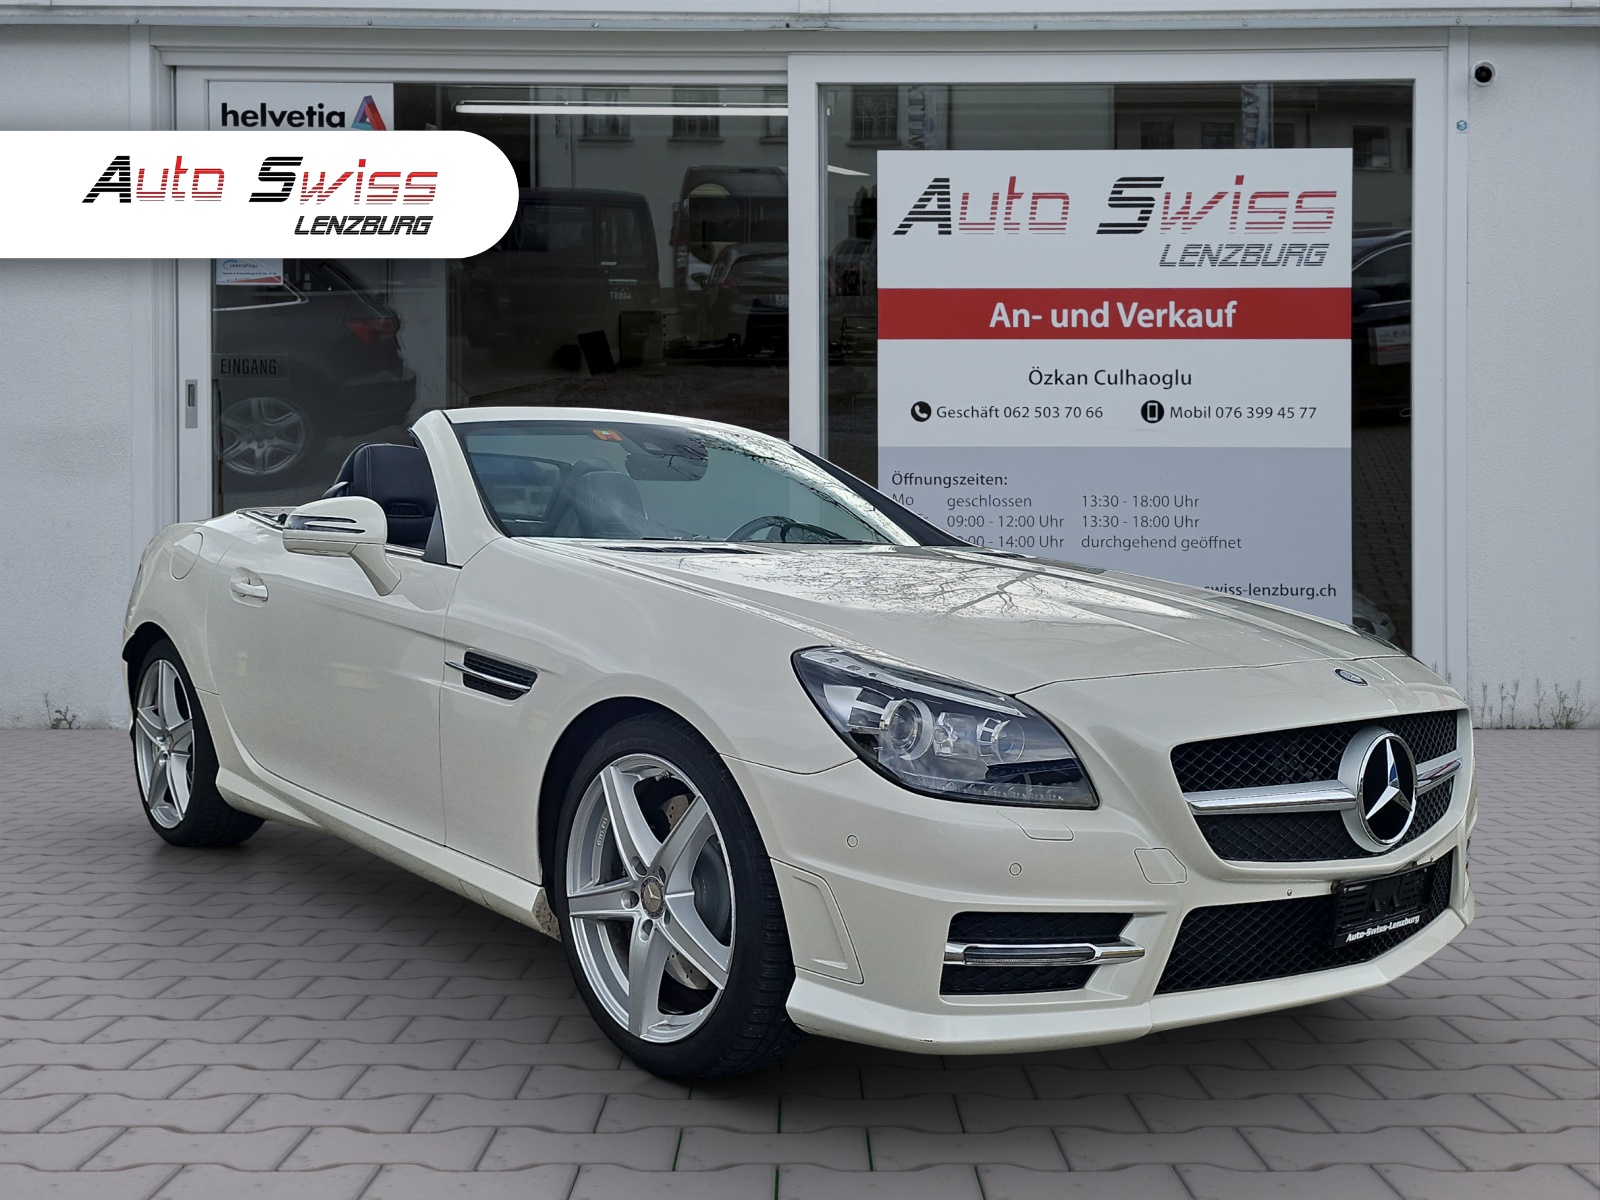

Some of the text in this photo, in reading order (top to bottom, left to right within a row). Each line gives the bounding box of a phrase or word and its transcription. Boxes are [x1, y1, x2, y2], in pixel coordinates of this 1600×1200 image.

[221, 102, 346, 128] helvetia
[892, 174, 1338, 235] Auto Swiss
[1159, 243, 1331, 268] LENZBURG
[988, 299, 1238, 329] An- und Verkauf
[220, 358, 277, 375] EINGANG
[1028, 365, 1192, 391] Özkan Culhaoglu
[936, 405, 1104, 419] Geschäft 062 503 70 66
[1169, 405, 1317, 419] Mobil 076 399 45 77
[891, 470, 1008, 489] Öffnungszeiten:
[892, 493, 1032, 511] Mo geschlossen
[1082, 494, 1119, 508] 13:30
[1132, 494, 1170, 508] 18:00
[1173, 494, 1200, 508] Uhr
[946, 515, 985, 528] 09:00
[998, 515, 1035, 528] 12:00
[1039, 514, 1065, 528] Uhr
[1082, 515, 1119, 528] 13:30
[1132, 515, 1170, 528] 18:00
[1174, 514, 1200, 528] Uhr
[998, 535, 1035, 548] 14:00
[1039, 534, 1065, 548] Uhr
[1081, 534, 1242, 552] durchgehend geöffnet
[1204, 583, 1337, 600] wiss-lenzburg.ch
